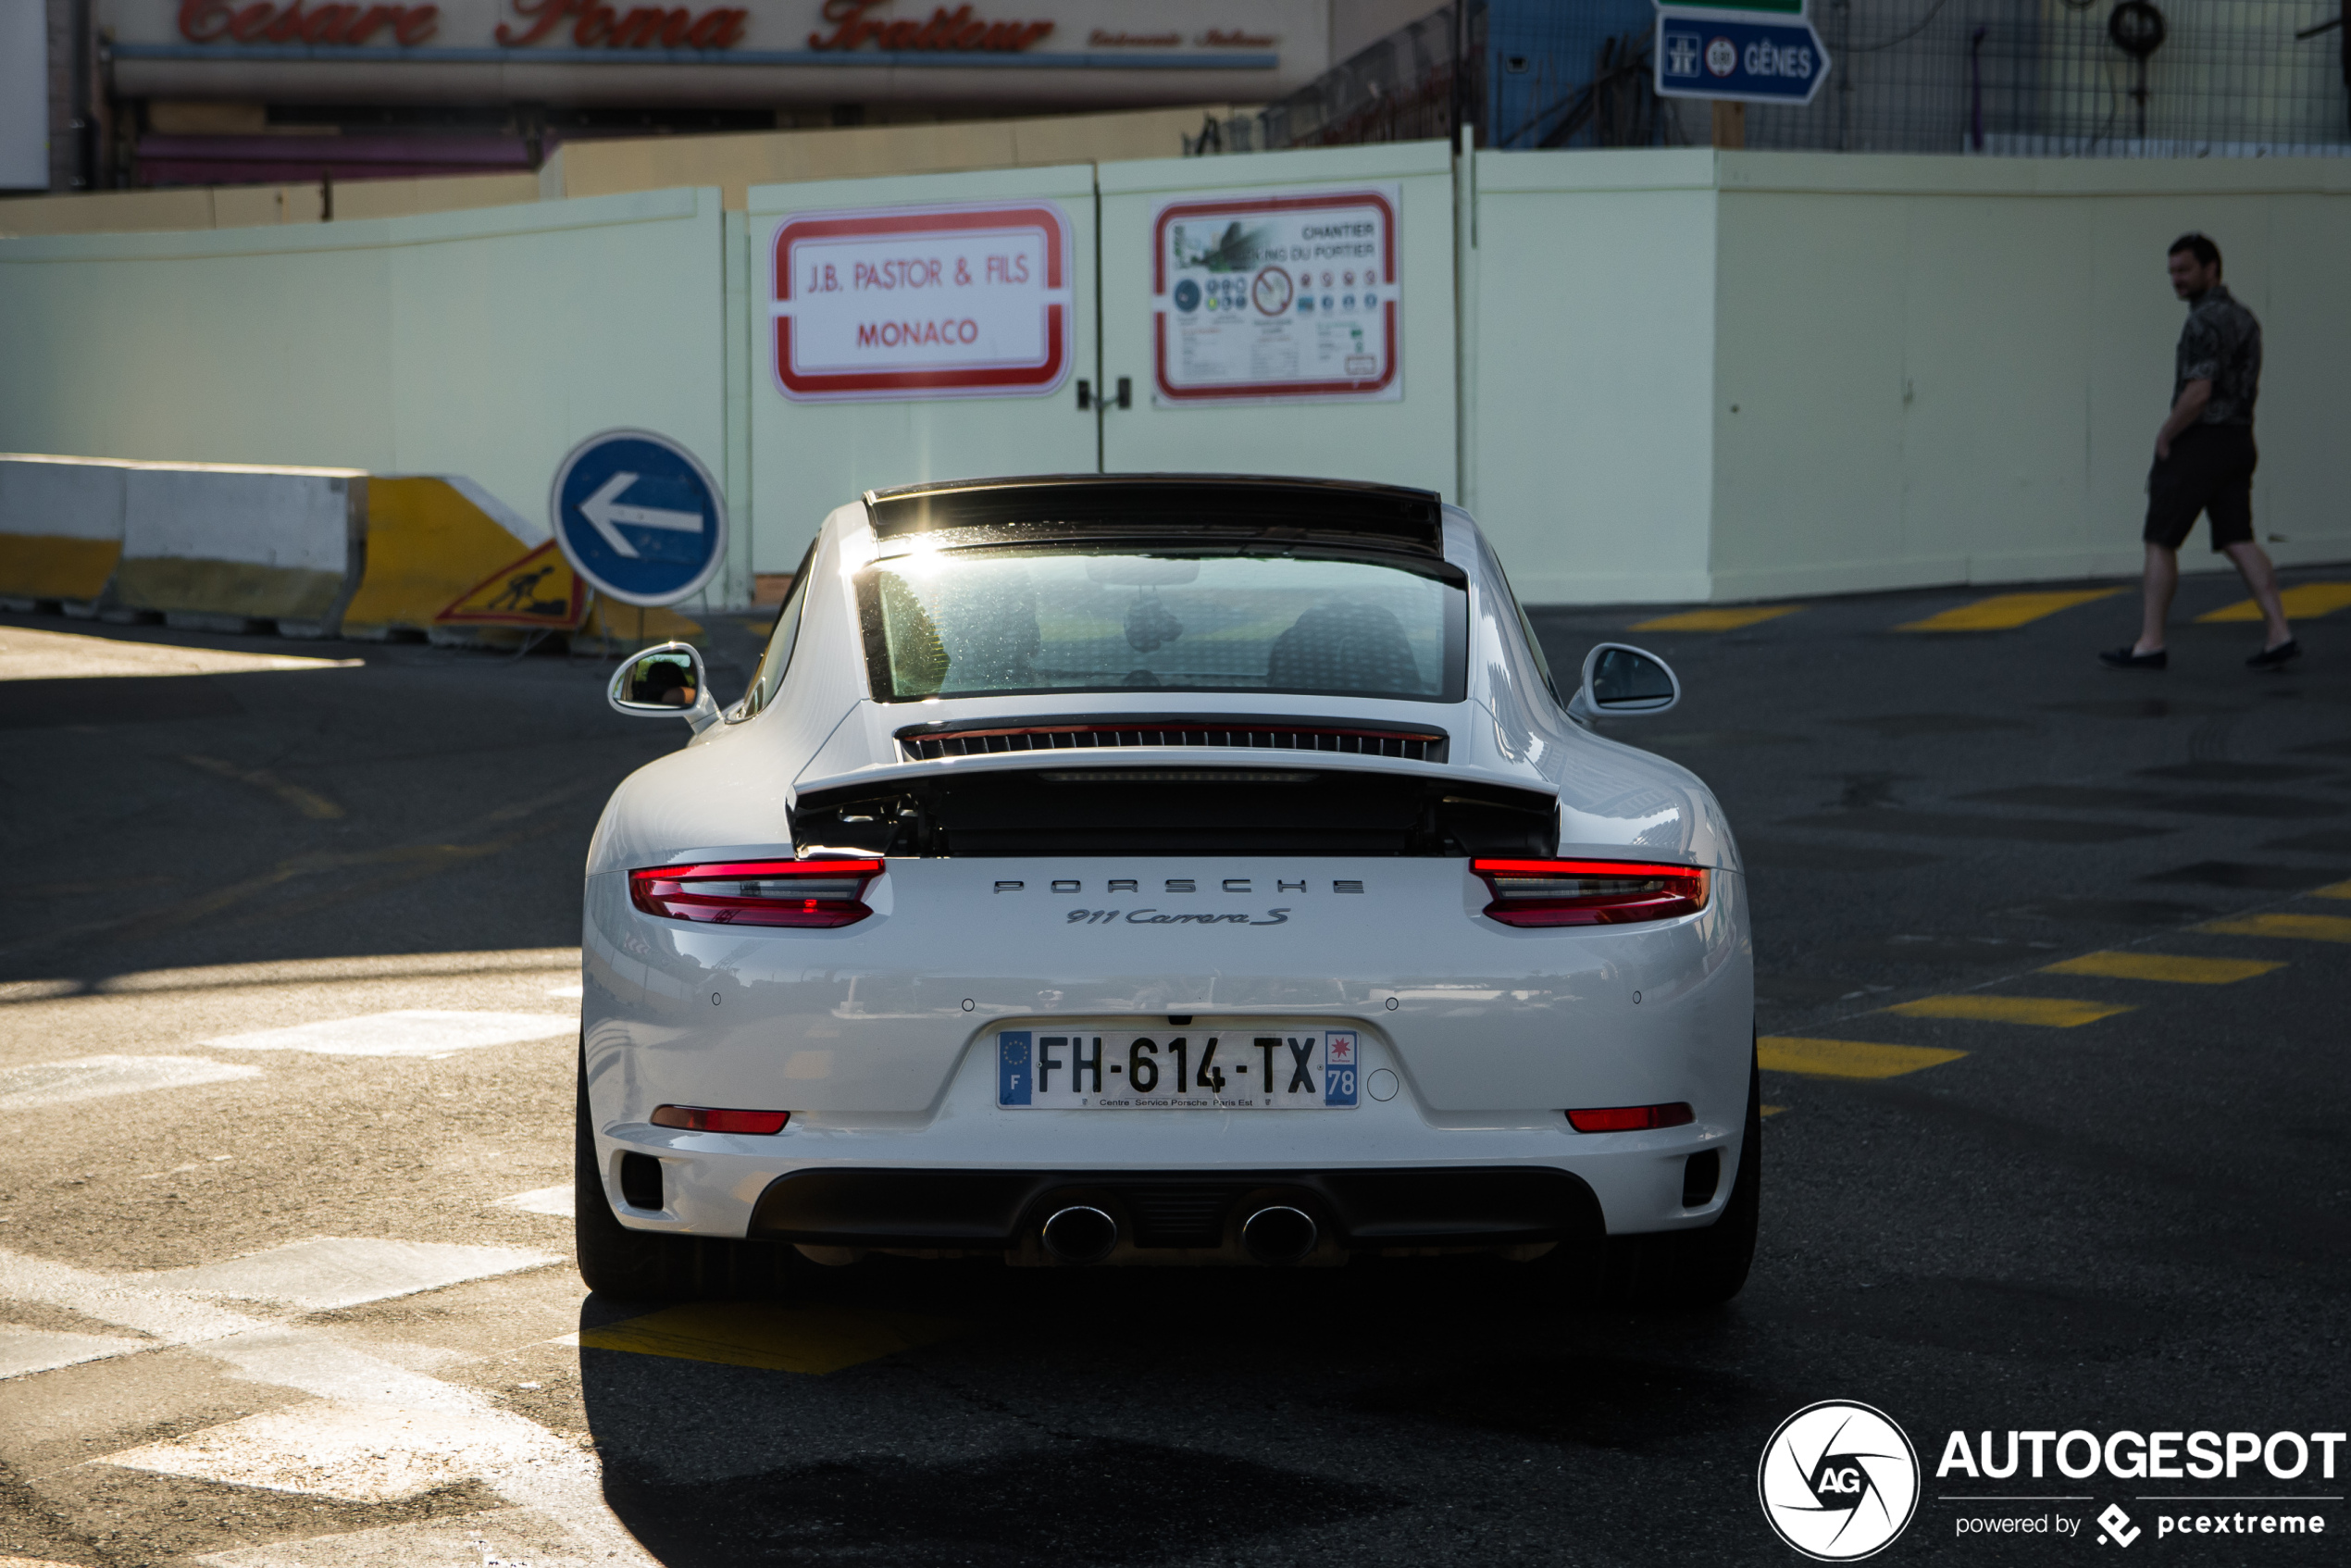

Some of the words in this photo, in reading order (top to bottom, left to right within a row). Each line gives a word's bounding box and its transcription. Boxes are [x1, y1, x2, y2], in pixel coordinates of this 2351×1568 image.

[179, 0, 439, 44] Cesare
[808, 0, 1053, 51] Traiteur
[1744, 38, 1812, 79] GÊNES
[1301, 223, 1375, 240] CHANTIER
[1290, 245, 1312, 260] DU
[1314, 243, 1375, 259] PORTIER
[808, 265, 843, 293] J.B.
[854, 259, 941, 291] PASTOR
[954, 256, 972, 286] &
[987, 255, 1029, 284] FILS
[858, 319, 978, 348] MONACO
[993, 879, 1364, 894] PORSCHE
[1066, 909, 1120, 924] 911
[1126, 909, 1250, 924] Carrera
[1250, 908, 1291, 926] S
[1039, 1036, 1315, 1093] FH-614-TX
[1011, 1075, 1020, 1089] F
[1327, 1070, 1354, 1095] 78
